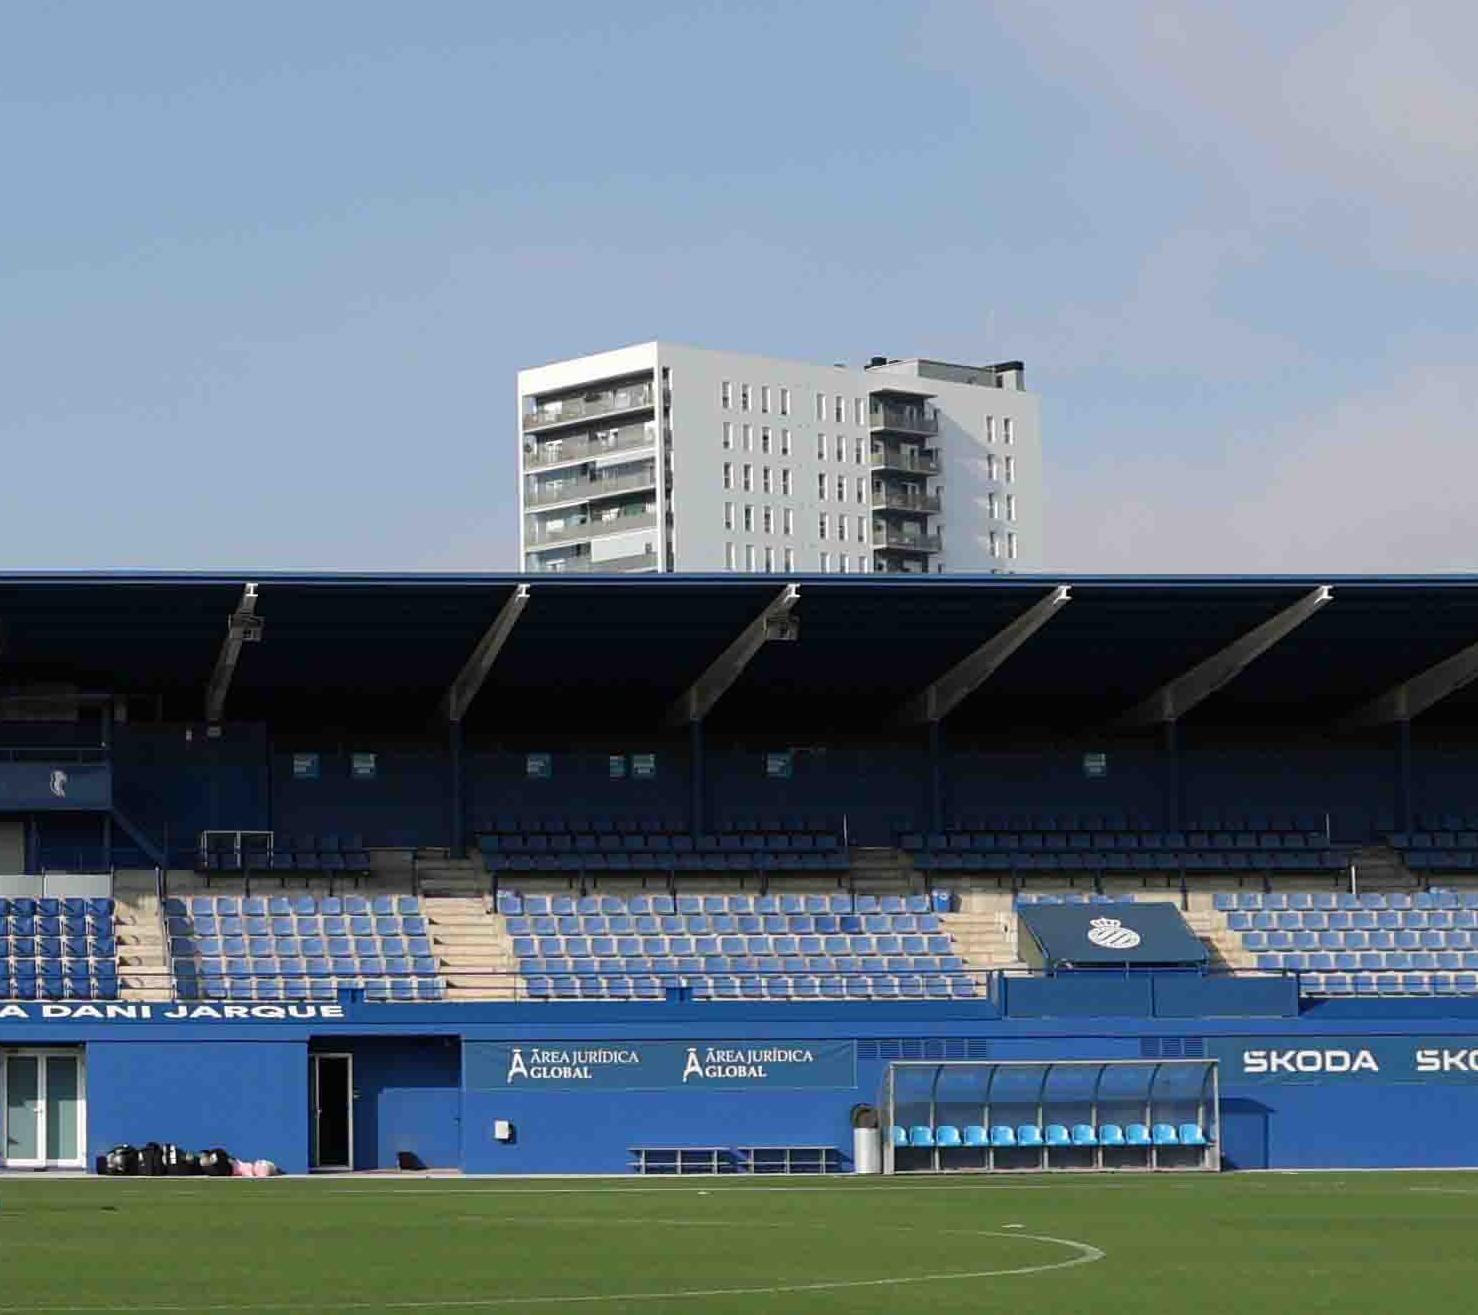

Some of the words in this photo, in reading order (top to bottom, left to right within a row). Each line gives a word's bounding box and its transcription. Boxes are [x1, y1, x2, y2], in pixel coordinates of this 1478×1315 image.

[42, 1005, 152, 1019] DANI
[164, 1005, 345, 1019] JARQUE
[571, 1048, 640, 1066] JURÍDICA
[746, 1047, 814, 1065] JURÍDICA
[529, 1066, 593, 1079] GLOBAL
[704, 1065, 767, 1078] GLOBAL
